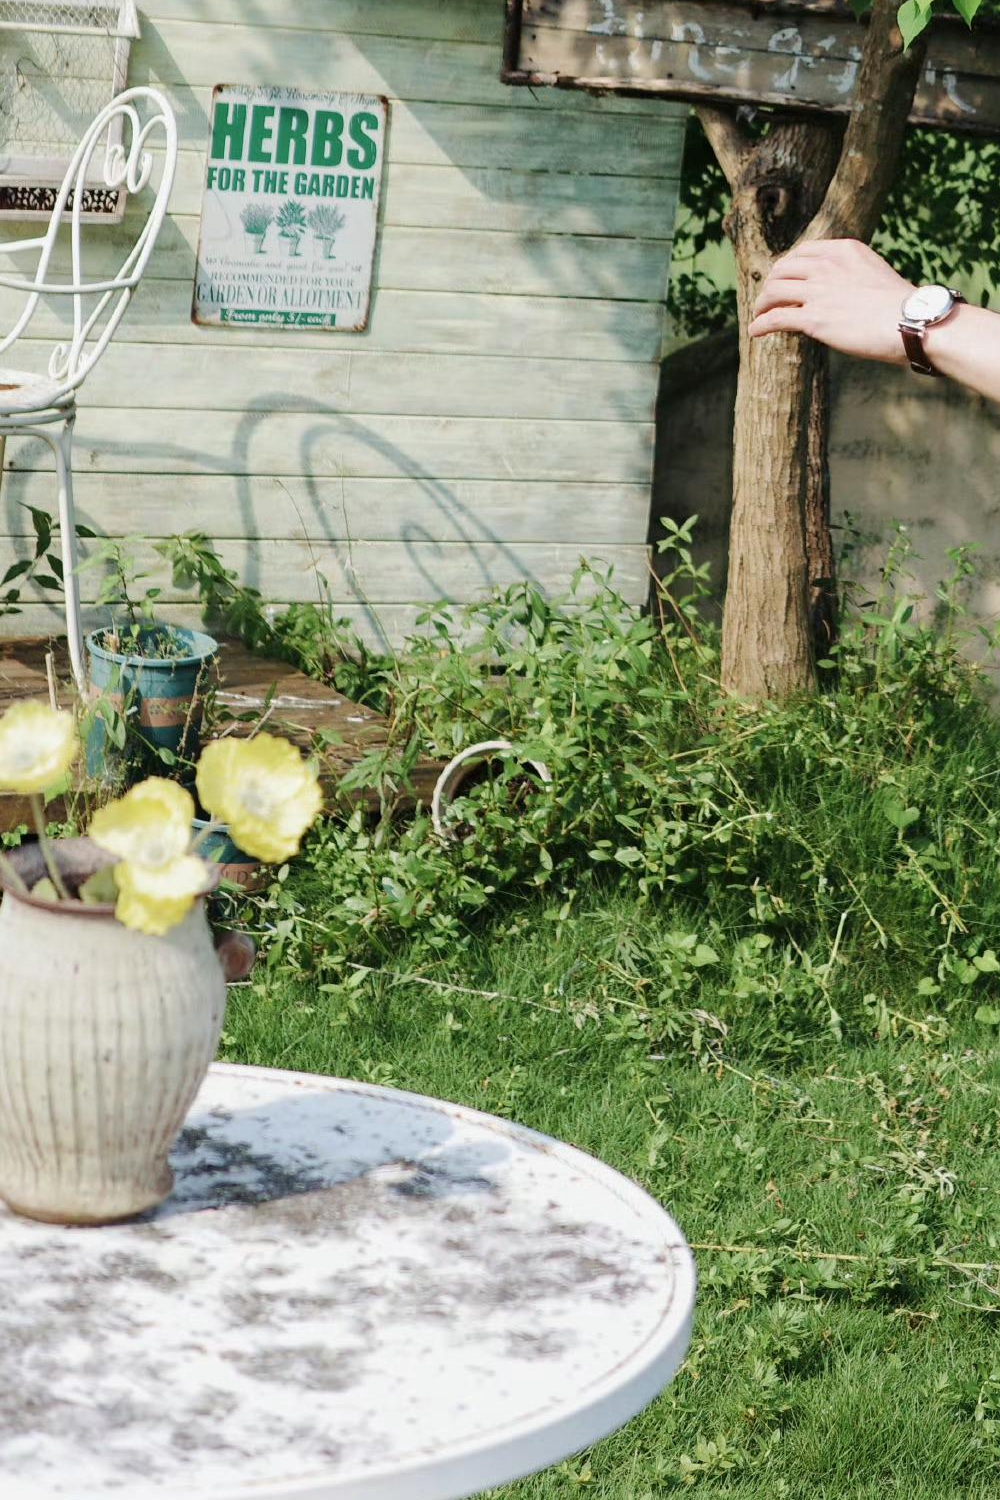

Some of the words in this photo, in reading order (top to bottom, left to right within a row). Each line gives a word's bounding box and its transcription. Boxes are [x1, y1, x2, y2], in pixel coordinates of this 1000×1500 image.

[210, 102, 379, 170] HERBS
[207, 166, 246, 193] FOR
[251, 169, 289, 195] THE
[293, 173, 375, 200] GARDEN
[211, 271, 298, 286] RECOMMENDED
[323, 277, 355, 288] YOUR
[196, 282, 254, 304] GARDEN
[257, 286, 277, 306] OR
[281, 288, 365, 310] ALLOTMENT
